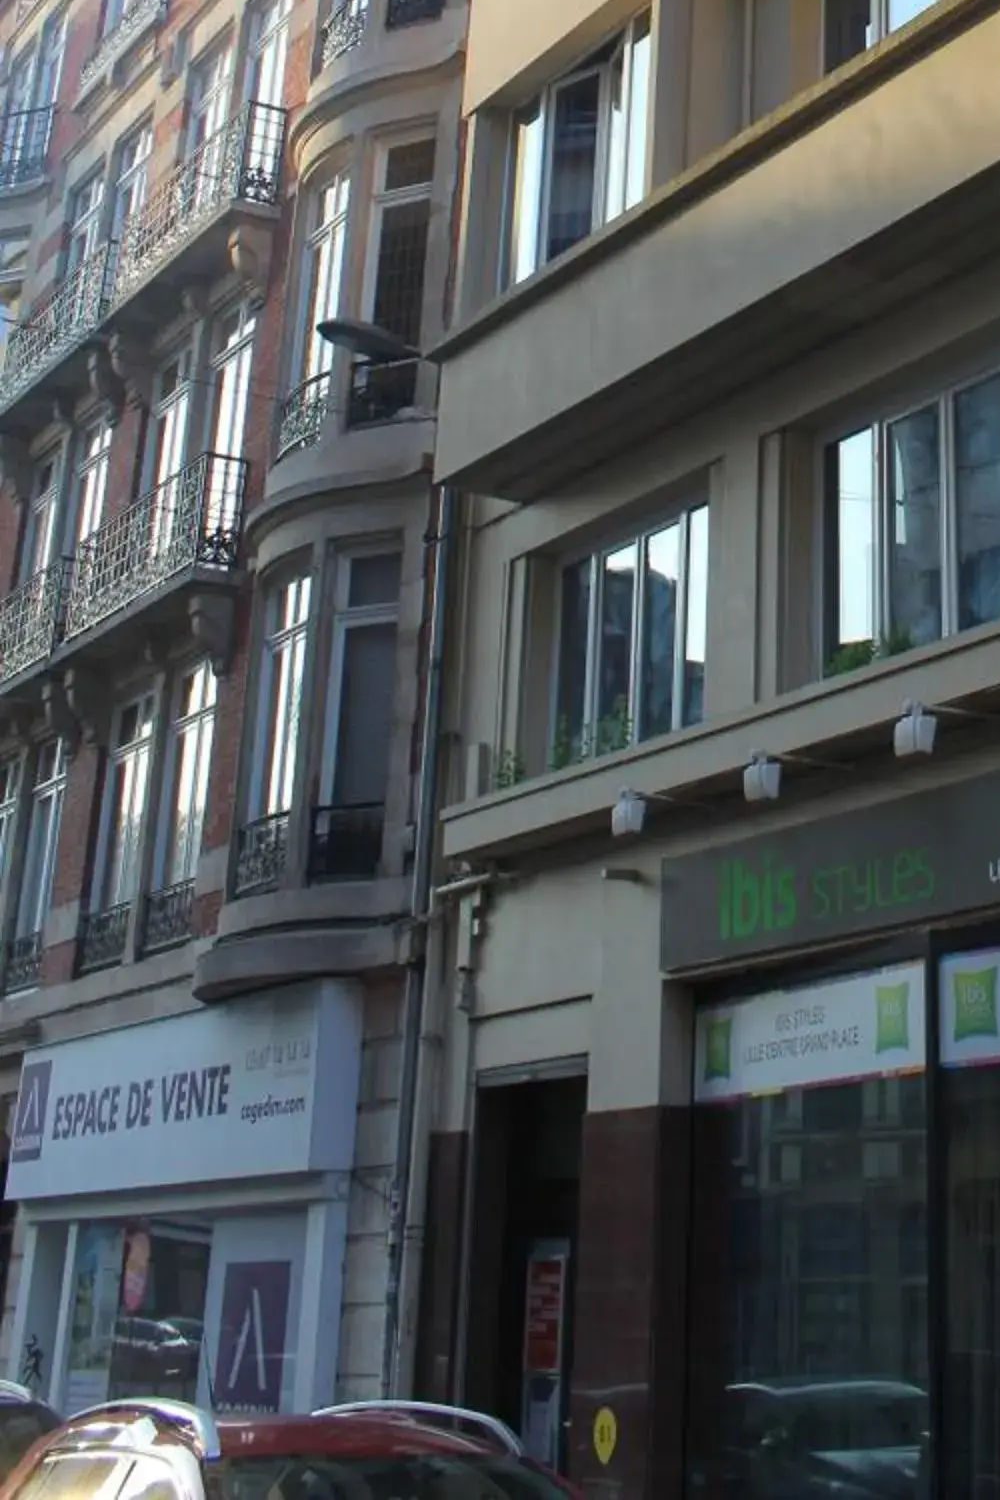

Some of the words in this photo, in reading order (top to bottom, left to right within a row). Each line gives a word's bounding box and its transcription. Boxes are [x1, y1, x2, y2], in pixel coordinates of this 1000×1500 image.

[718, 854, 797, 940] ibis
[51, 1084, 122, 1140] ESPACE
[125, 1079, 153, 1130] DE
[161, 1063, 231, 1123] VENTE
